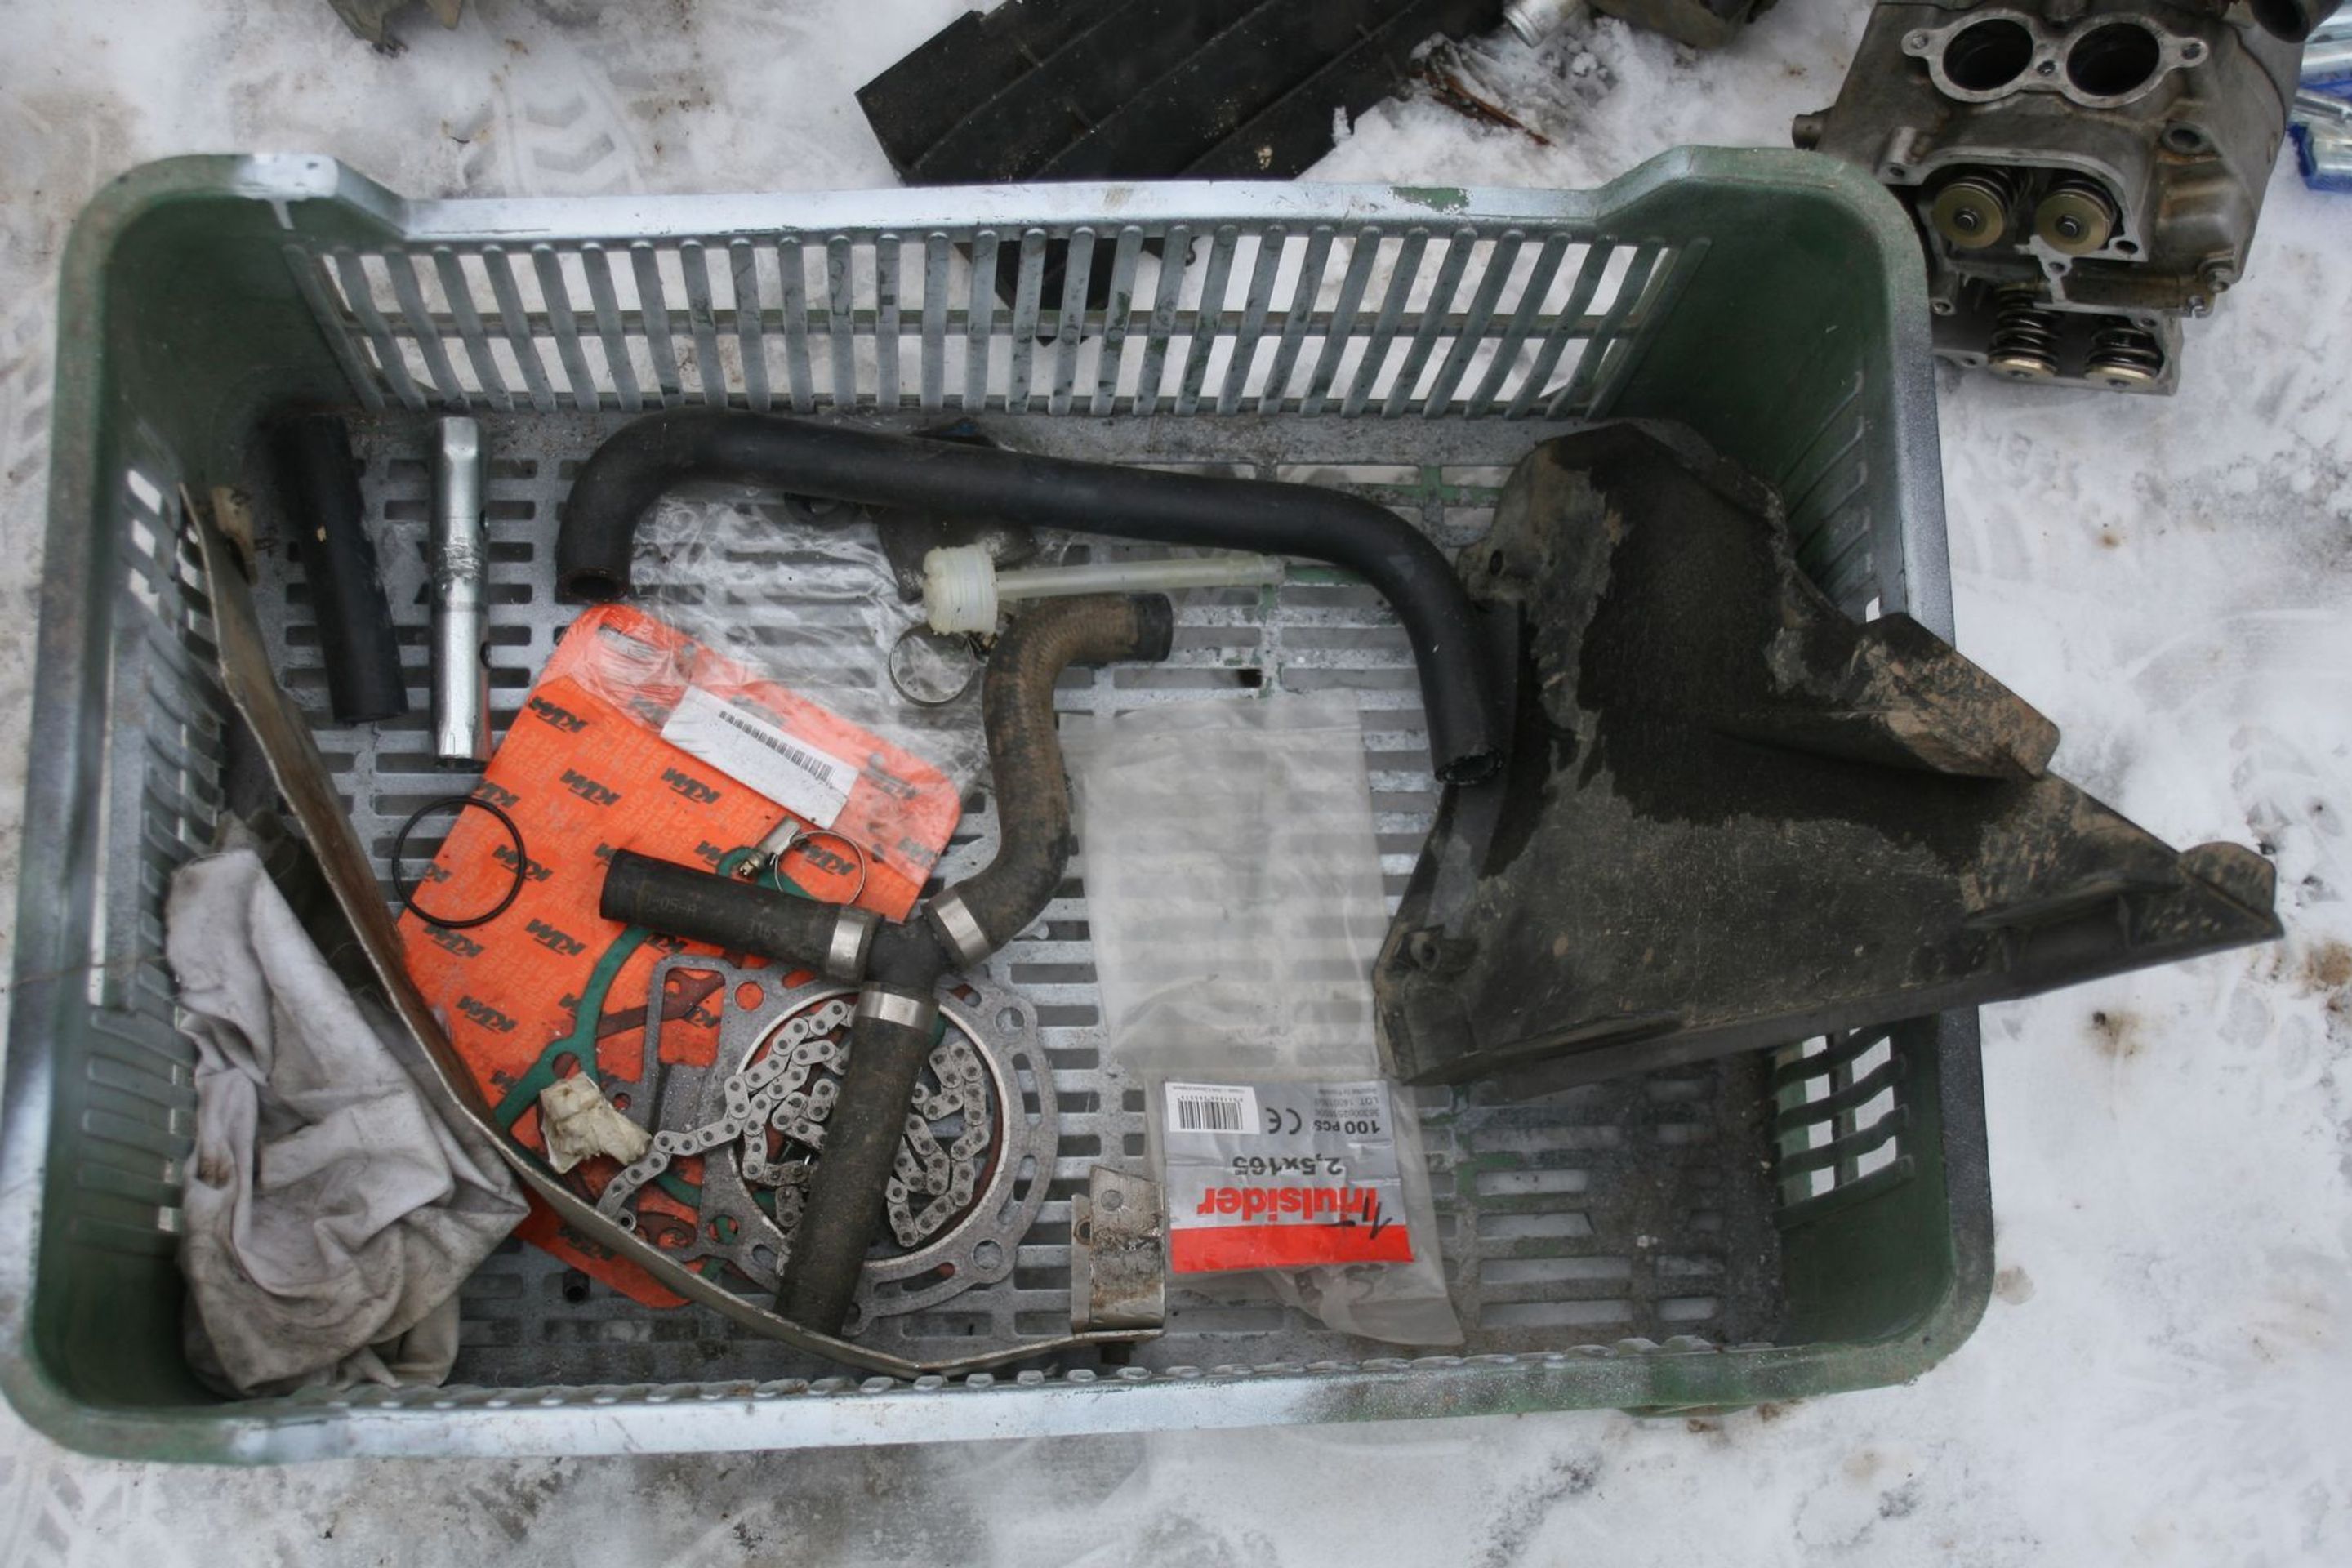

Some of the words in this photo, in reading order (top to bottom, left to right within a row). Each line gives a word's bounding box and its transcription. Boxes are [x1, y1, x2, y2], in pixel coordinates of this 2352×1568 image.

[527, 695, 588, 733] KTM
[559, 768, 620, 806] KTM
[660, 766, 721, 804] KTM
[491, 844, 553, 882] KTM
[422, 922, 484, 958] KTM
[523, 918, 586, 956] KTM
[455, 995, 517, 1034] KTM
[1315, 1120, 1339, 1132] PCS
[1345, 1120, 1381, 1134] 100
[1232, 1153, 1343, 1176] 2,5x165
